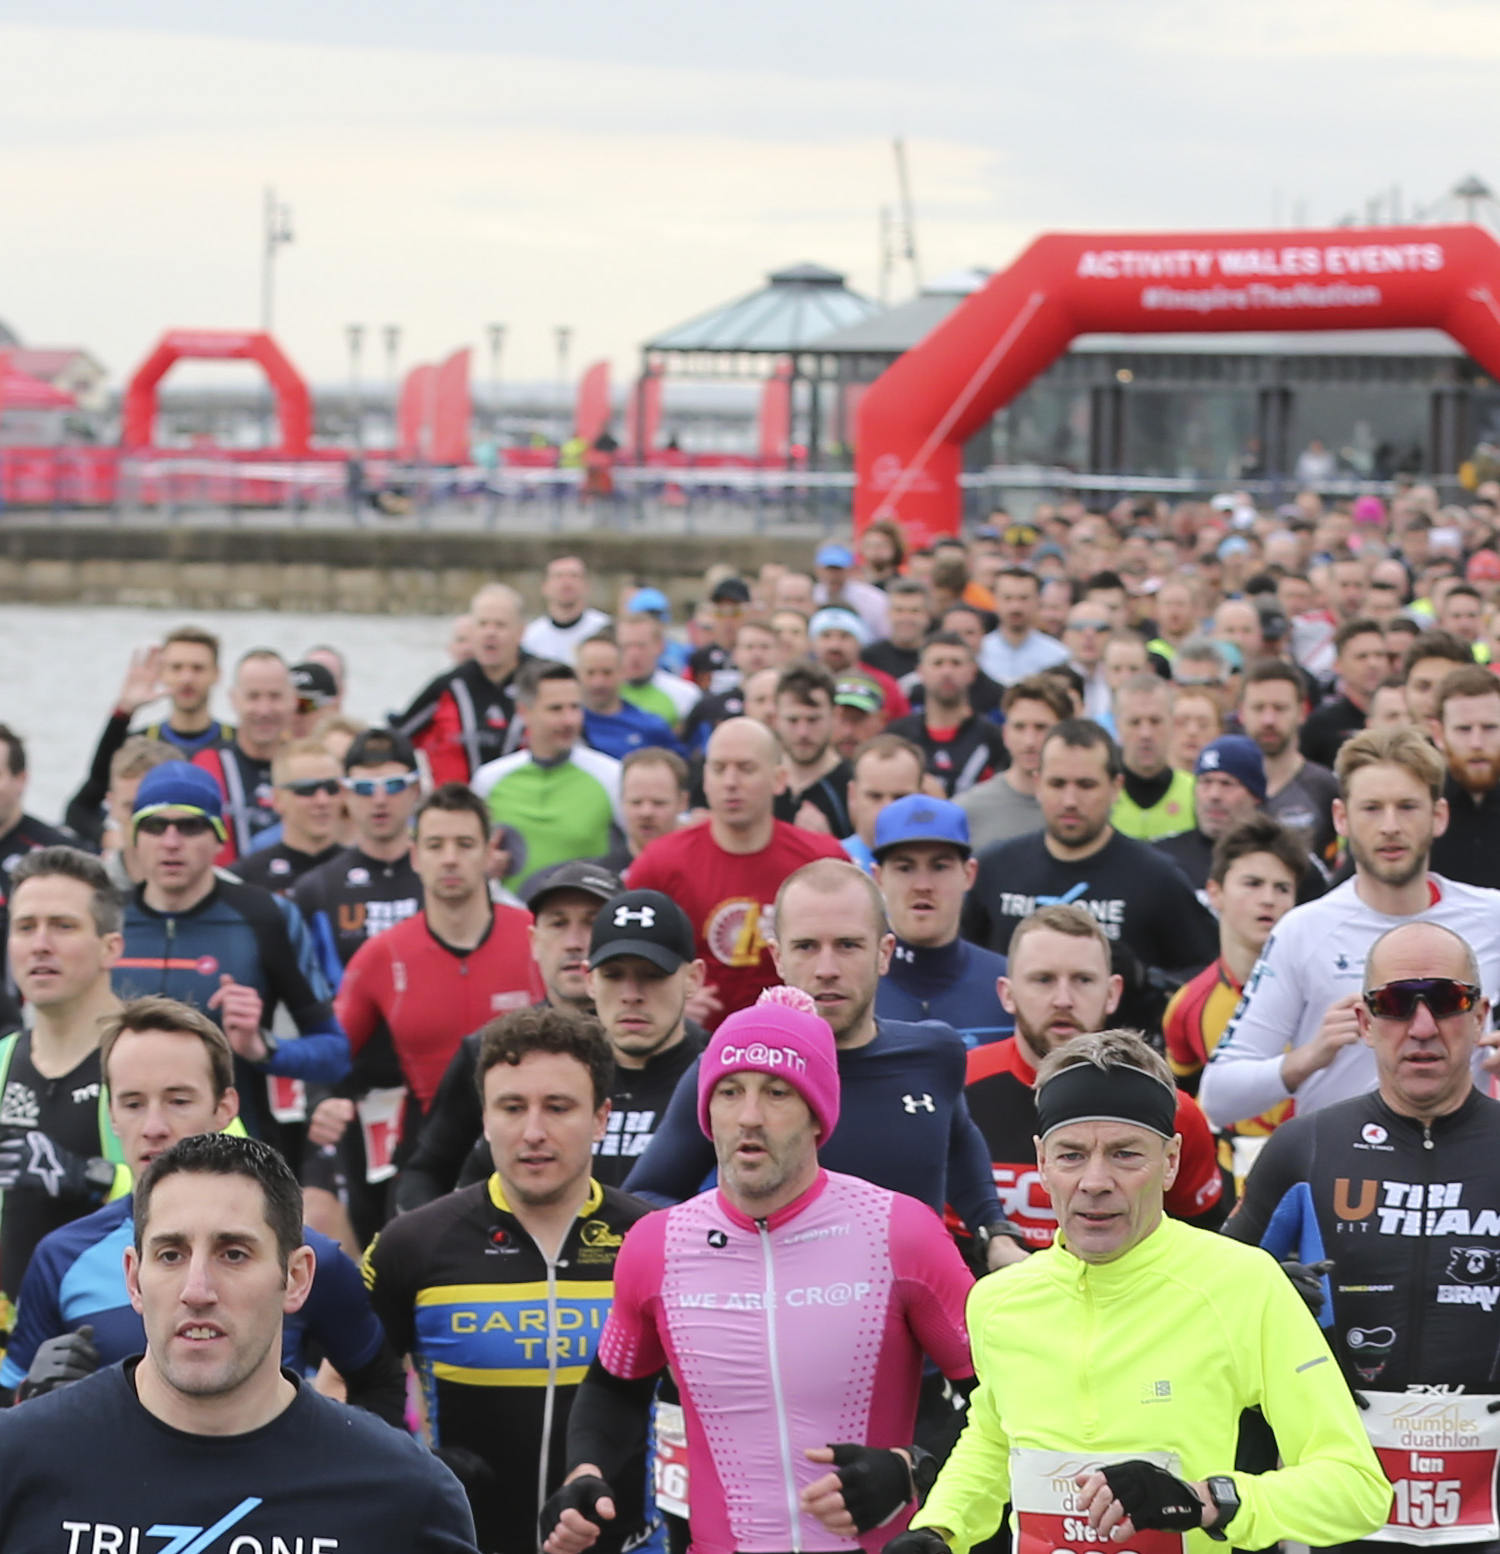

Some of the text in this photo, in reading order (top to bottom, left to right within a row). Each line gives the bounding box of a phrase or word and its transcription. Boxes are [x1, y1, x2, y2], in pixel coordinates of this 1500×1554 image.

[1077, 243, 1444, 278] ACTIVITY WALES EVENTS
[1333, 1178, 1378, 1221] U
[679, 1293, 717, 1310] WE
[785, 1283, 872, 1307] CR@P
[451, 1307, 614, 1333] CARDI
[513, 1336, 588, 1360] TRI
[1392, 1407, 1479, 1432] mumbles
[1400, 1431, 1480, 1448] duathlon
[1409, 1452, 1445, 1474] Ian
[1392, 1478, 1462, 1528] 155
[1063, 1517, 1121, 1543] Ste
